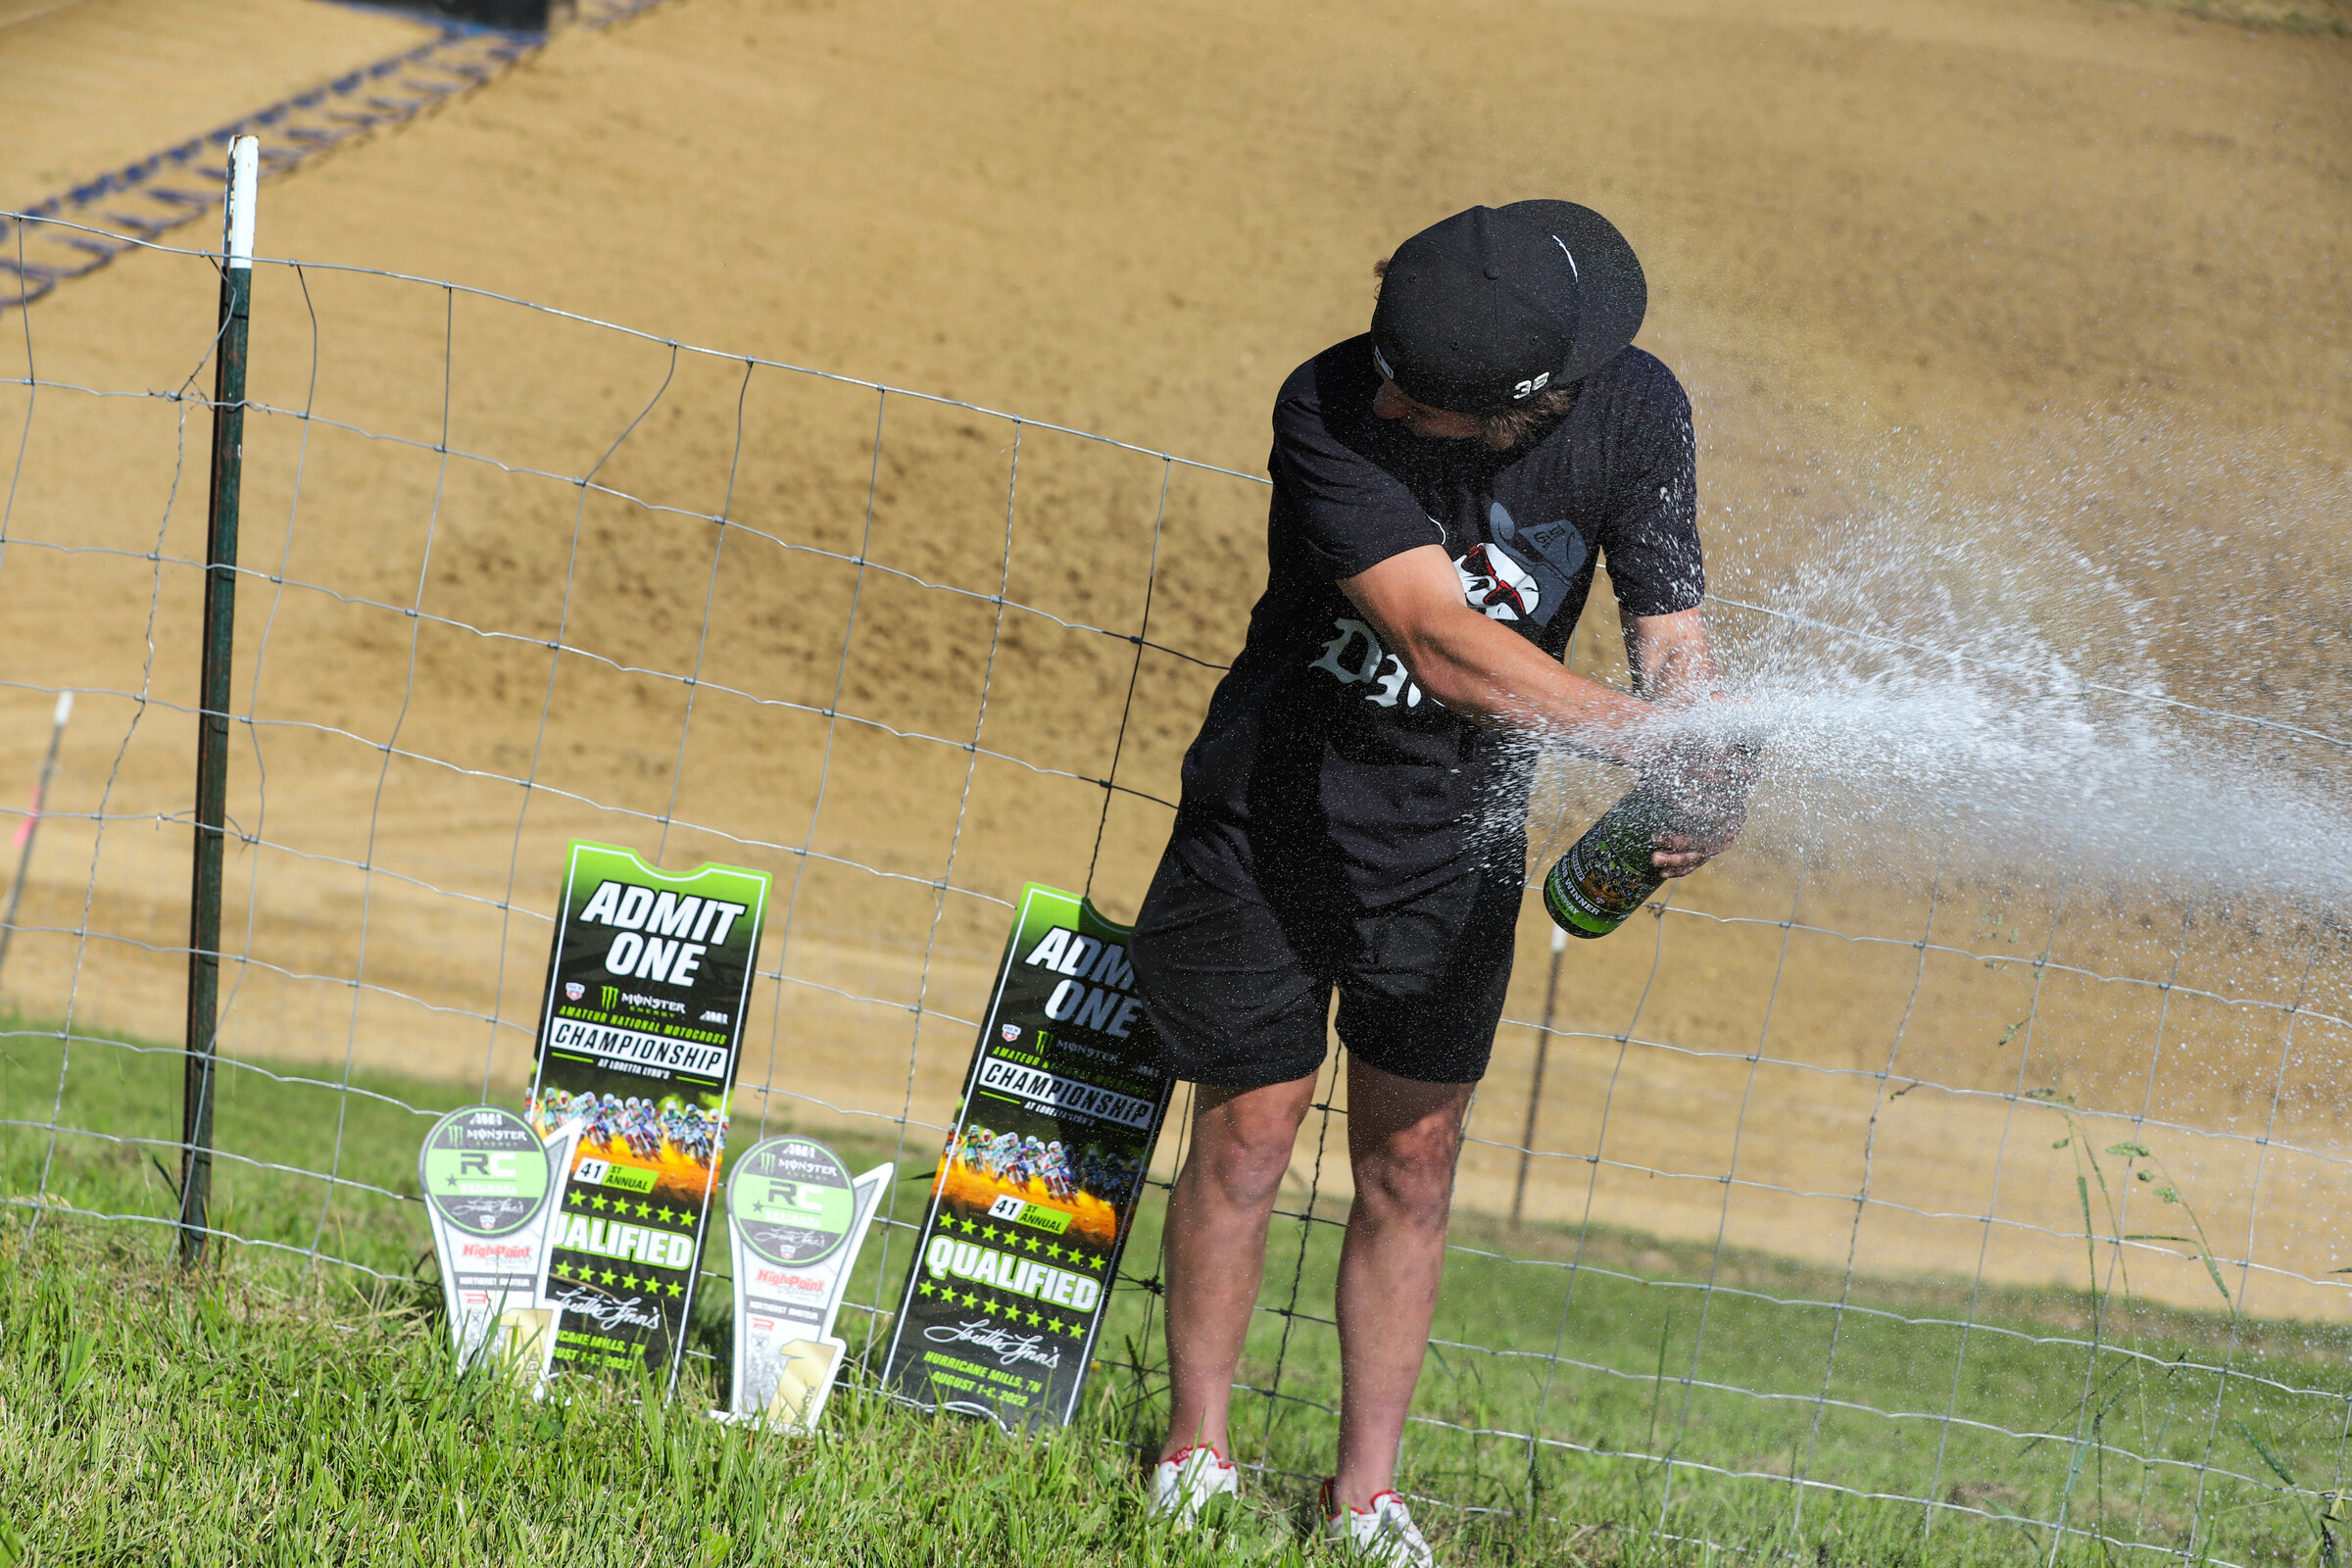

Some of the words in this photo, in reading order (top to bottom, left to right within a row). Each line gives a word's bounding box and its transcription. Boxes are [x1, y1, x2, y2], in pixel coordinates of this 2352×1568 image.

[1565, 878, 1600, 915] WINNER
[579, 881, 746, 945] ADMIT
[605, 931, 708, 987] ONE
[1025, 926, 1136, 992] ADM
[621, 993, 686, 1014] MONSTER
[1045, 979, 1145, 1039] ONE
[559, 1005, 608, 1023] AMATEUR
[610, 1014, 661, 1033] NATIONAL
[663, 1024, 727, 1046] MOTOCROSS
[555, 1023, 723, 1071] CHAMPIONSHIP
[992, 1046, 1039, 1065] AMATEUR
[597, 1058, 609, 1069] AT
[984, 1063, 1152, 1123] CHAMPIONSHIP
[1024, 1101, 1036, 1111] AT
[466, 1128, 527, 1142] MONSTER
[461, 1152, 516, 1178] RC
[580, 1162, 602, 1179] 41
[612, 1165, 622, 1175] ST
[778, 1158, 838, 1177] MONSTER
[606, 1175, 649, 1191] ANNUAL
[767, 1180, 824, 1211] RC
[996, 1200, 1018, 1215] 41
[1020, 1213, 1062, 1232] ANNUAL
[927, 1236, 1101, 1311] QUALIFIED
[604, 1355, 633, 1371] 2022
[923, 1350, 990, 1378] HURRICANE
[987, 1369, 1023, 1390] MILLS,
[1026, 1380, 1043, 1394] TN
[931, 1371, 977, 1392] AUGUST
[998, 1390, 1029, 1407] 2022
